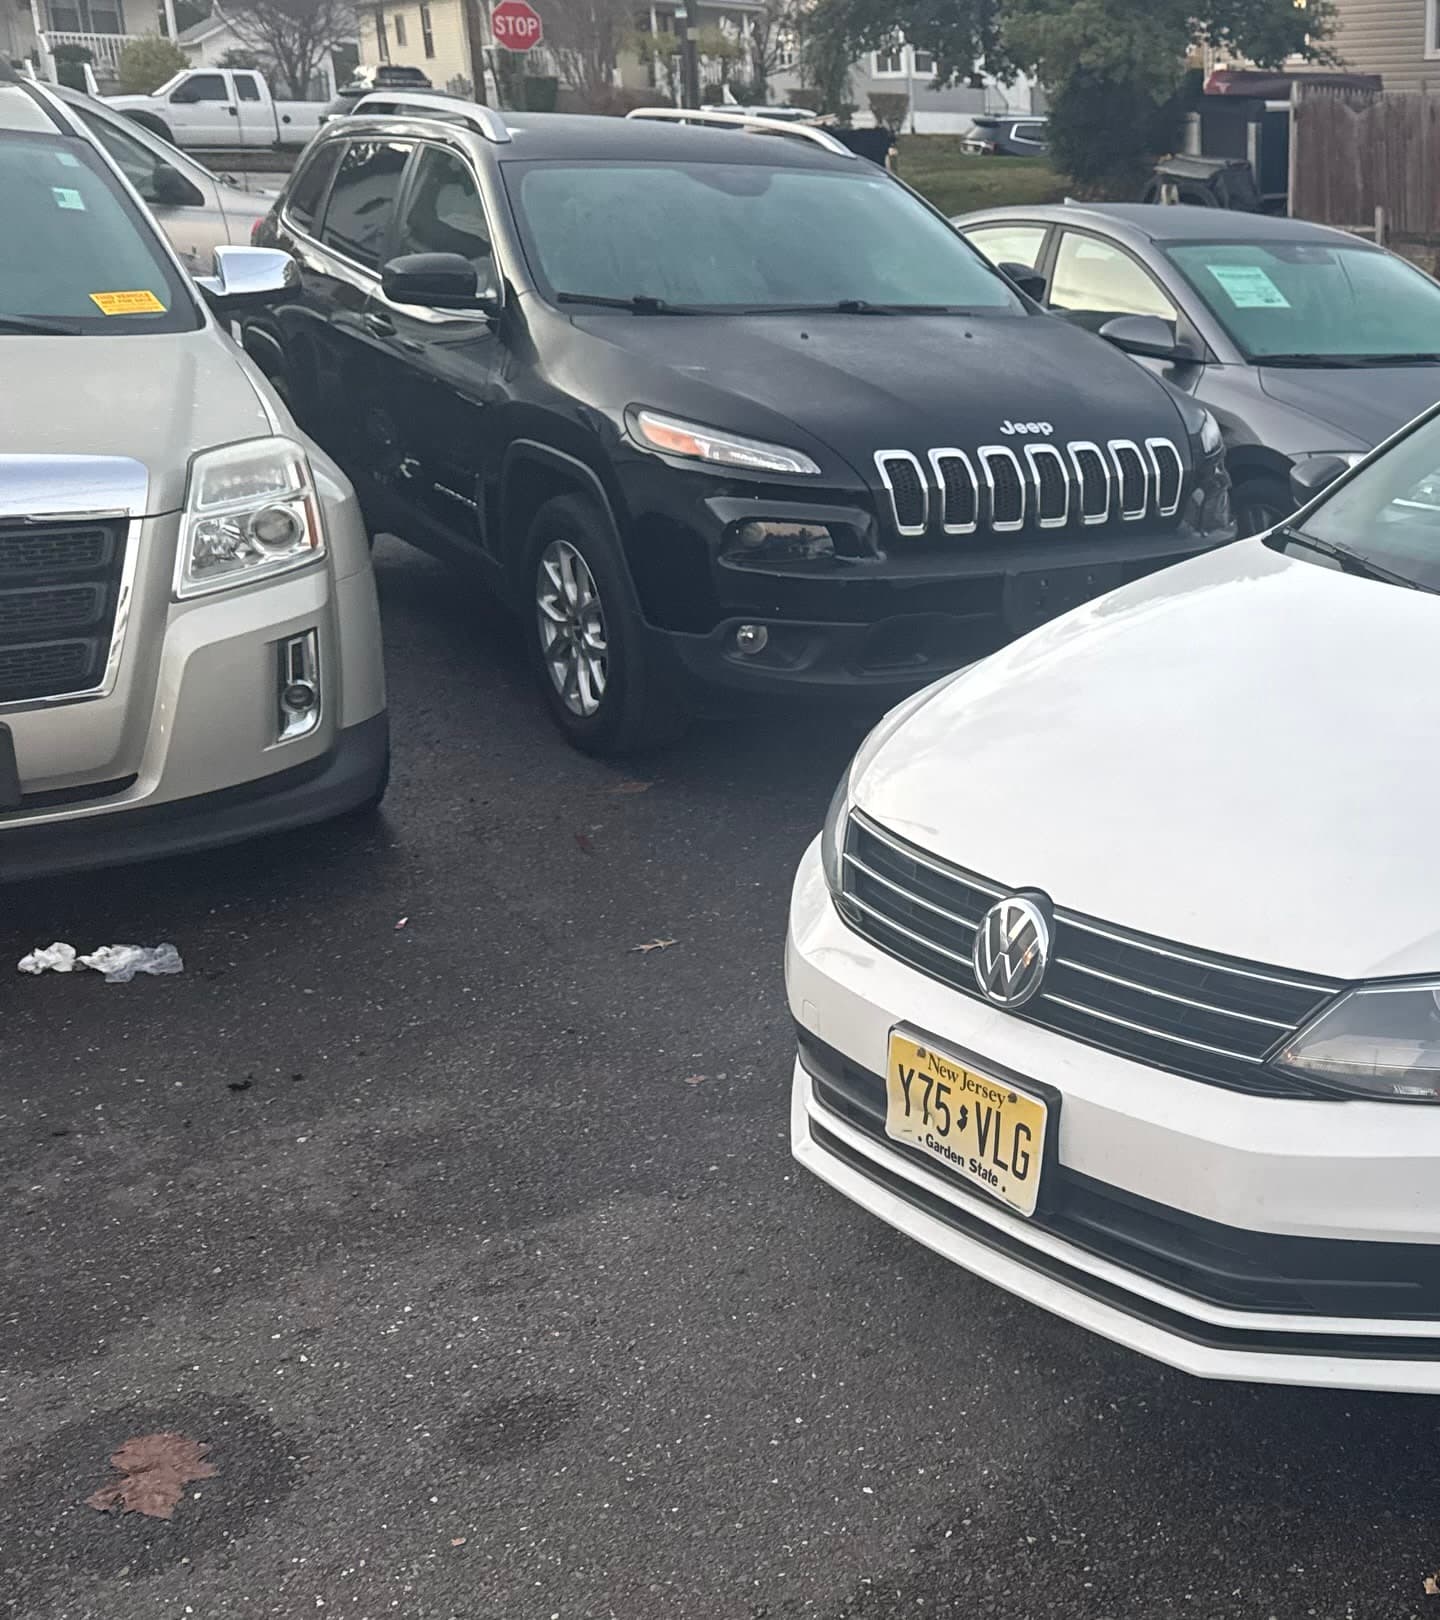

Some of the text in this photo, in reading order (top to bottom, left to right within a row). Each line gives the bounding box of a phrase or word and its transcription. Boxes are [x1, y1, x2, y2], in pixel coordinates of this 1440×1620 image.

[495, 15, 538, 36] STOP
[1000, 420, 1054, 436] Jeep
[928, 1054, 1007, 1108] New Jersey
[898, 1063, 1032, 1181] Y75 VLG
[926, 1133, 999, 1187] Garden State
